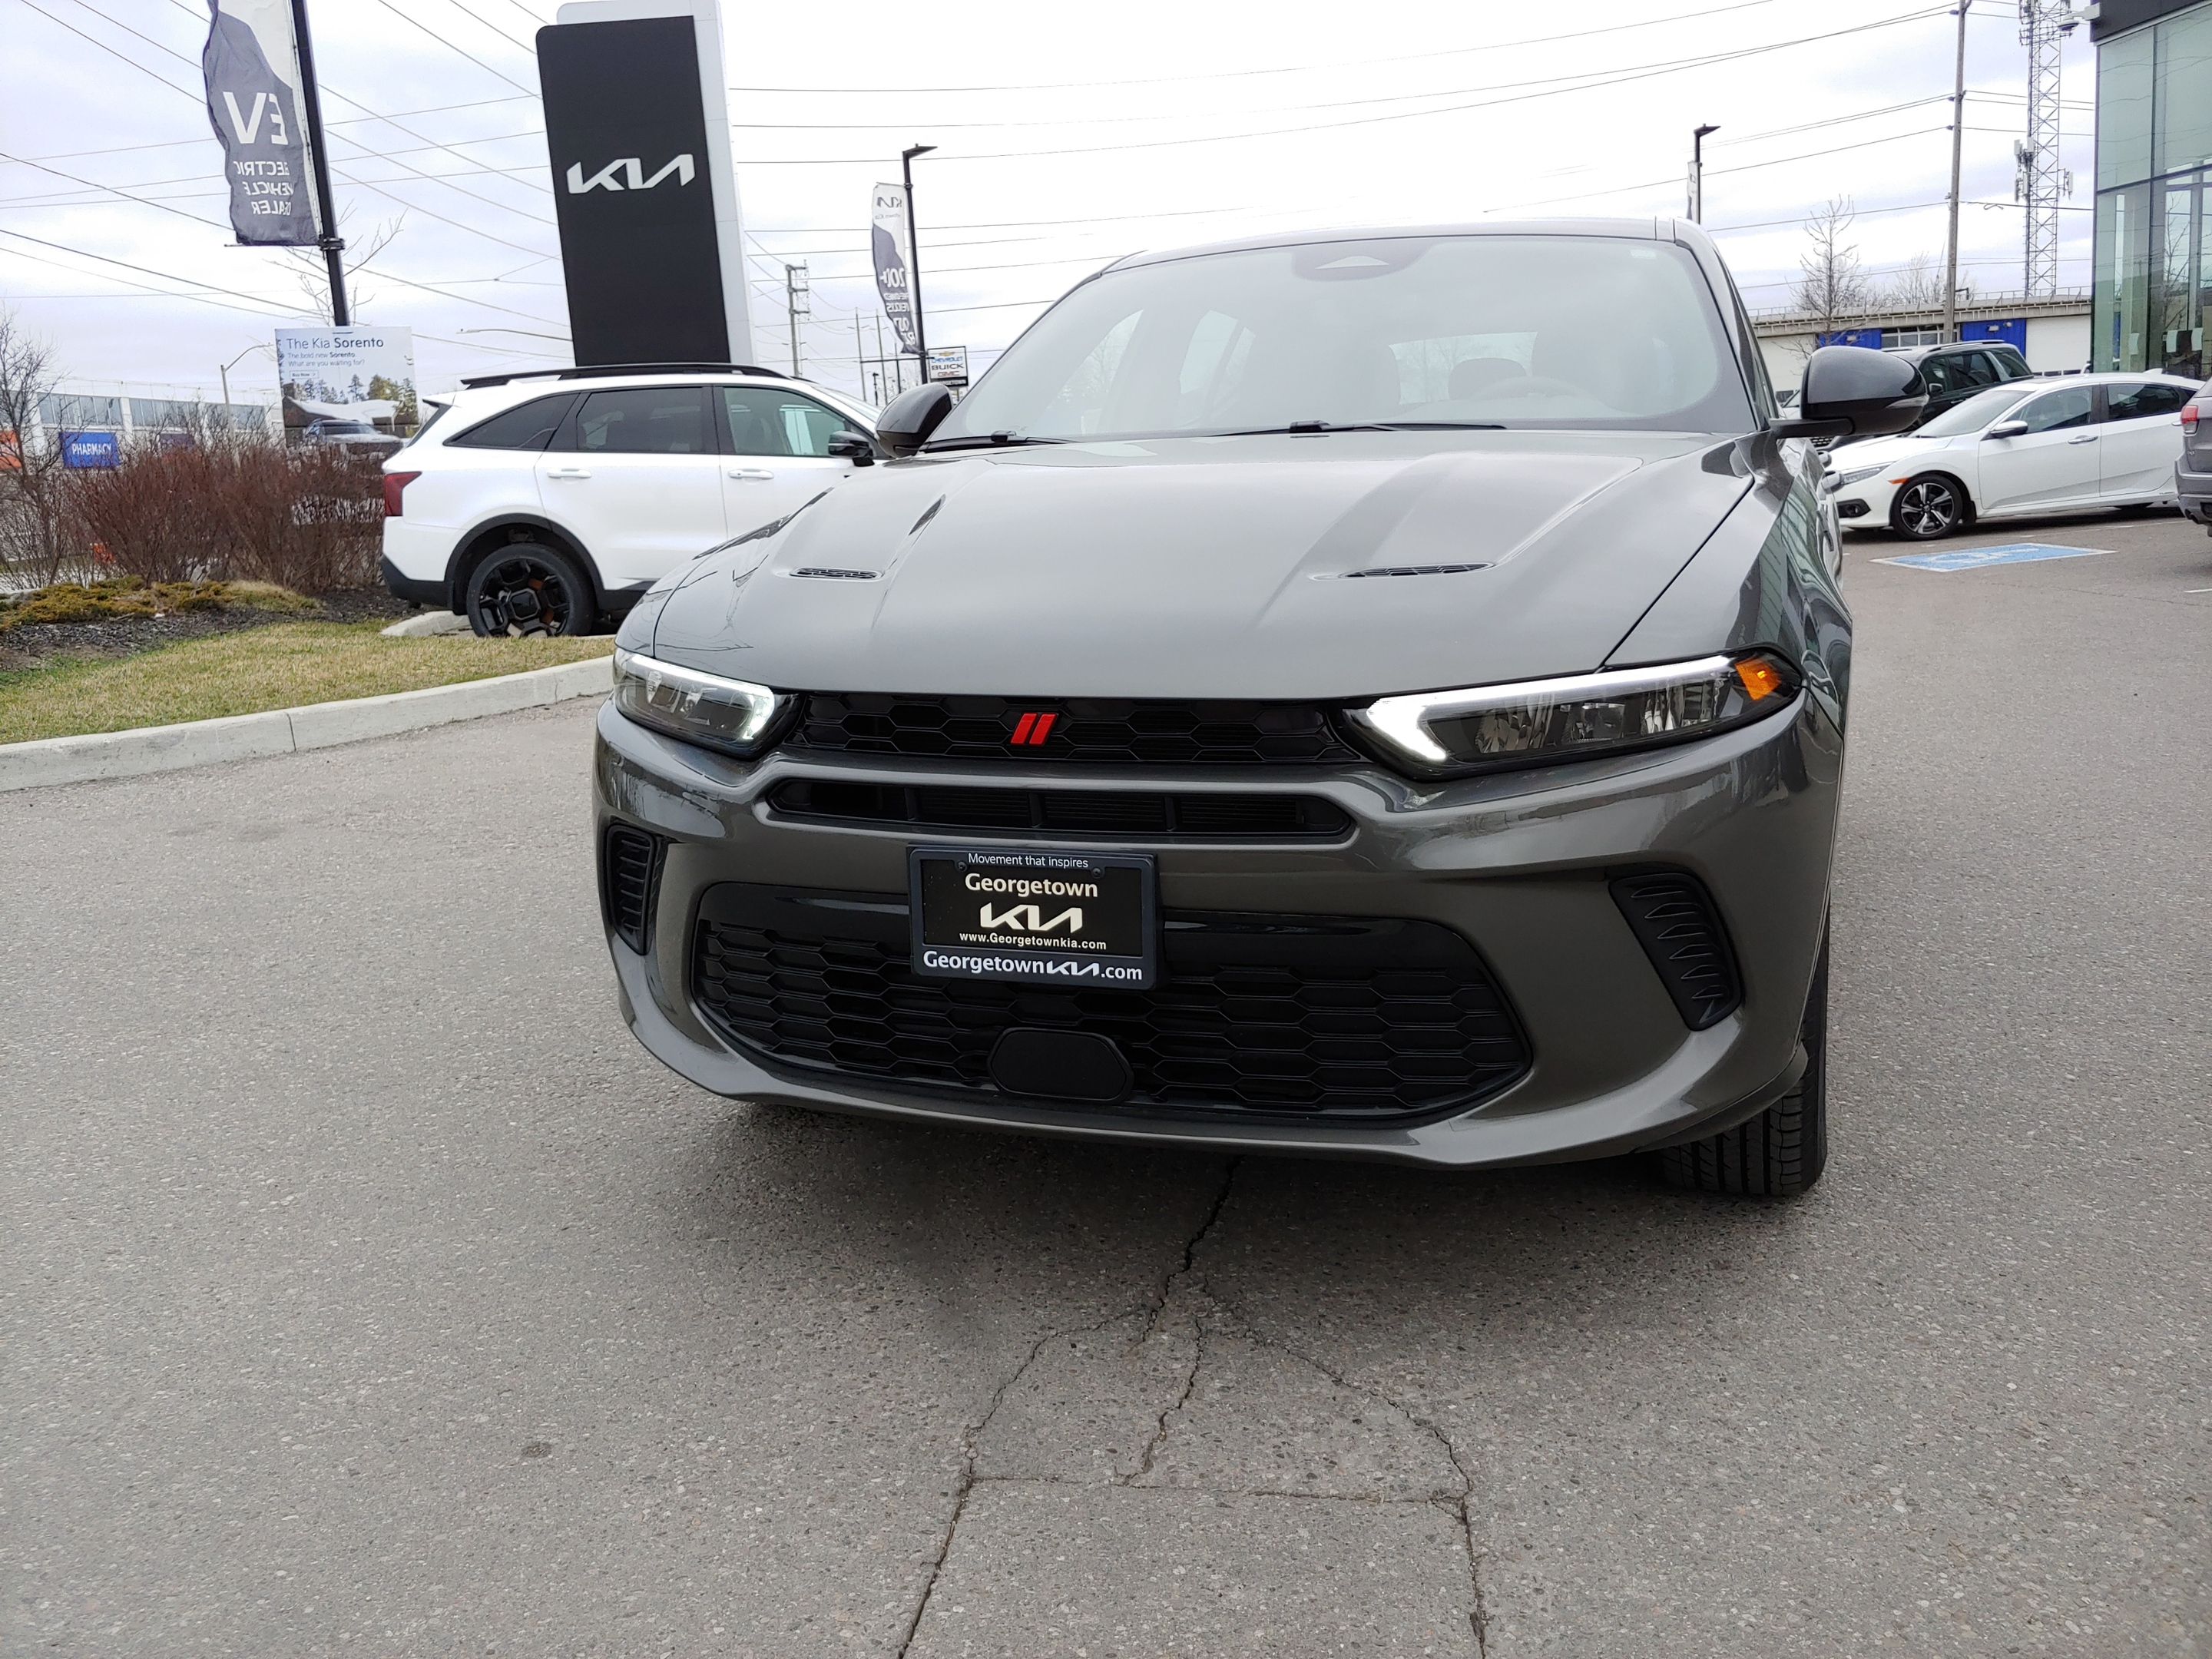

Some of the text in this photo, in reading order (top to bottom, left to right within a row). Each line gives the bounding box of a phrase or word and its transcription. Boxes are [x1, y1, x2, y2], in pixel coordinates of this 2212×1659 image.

[567, 154, 695, 194] KIA
[286, 337, 384, 349] The Kia Sorento
[931, 363, 965, 371] BUICK
[71, 442, 112, 456] PHARMACY
[969, 853, 1088, 869] Movement that inspires
[965, 873, 1098, 897] Georgetown
[980, 902, 1083, 933] KIA
[959, 932, 1107, 950] www.Georgetownkia.com
